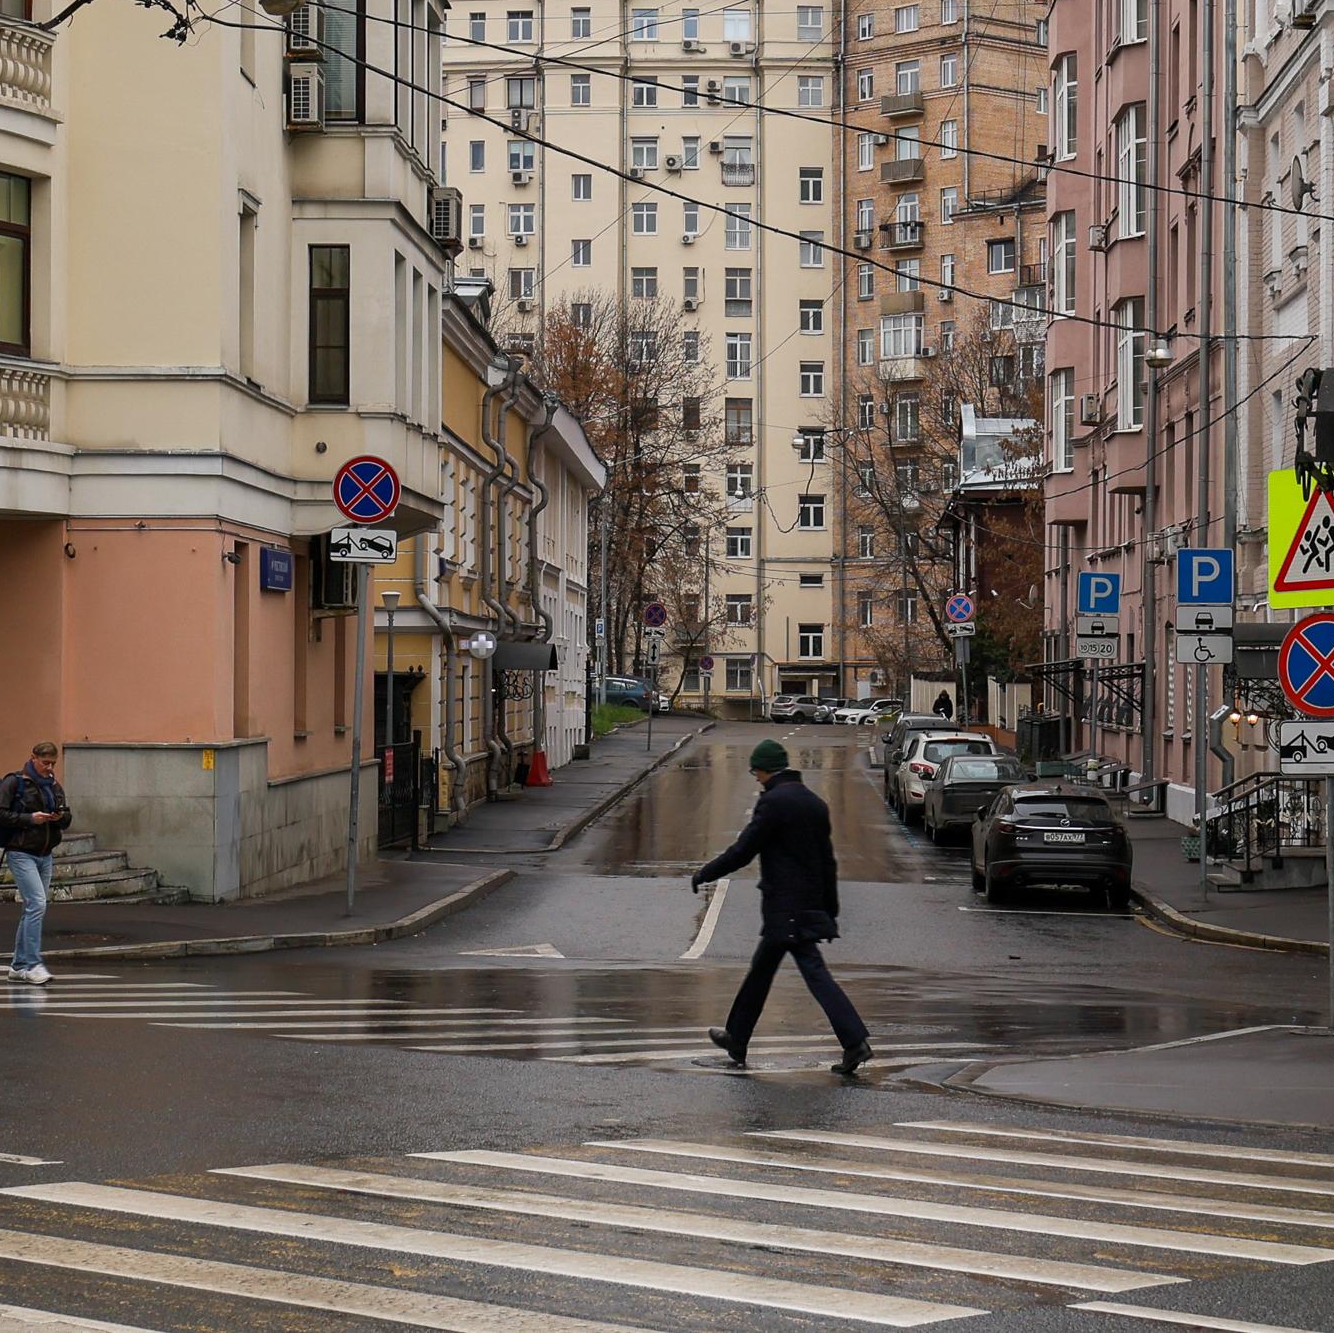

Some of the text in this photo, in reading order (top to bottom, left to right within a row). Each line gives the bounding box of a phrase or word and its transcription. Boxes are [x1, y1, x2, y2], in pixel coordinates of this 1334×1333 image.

[1192, 556, 1221, 597] P
[1089, 577, 1113, 609] P
[1089, 644, 1098, 652] 15
[1100, 644, 1113, 654] 20
